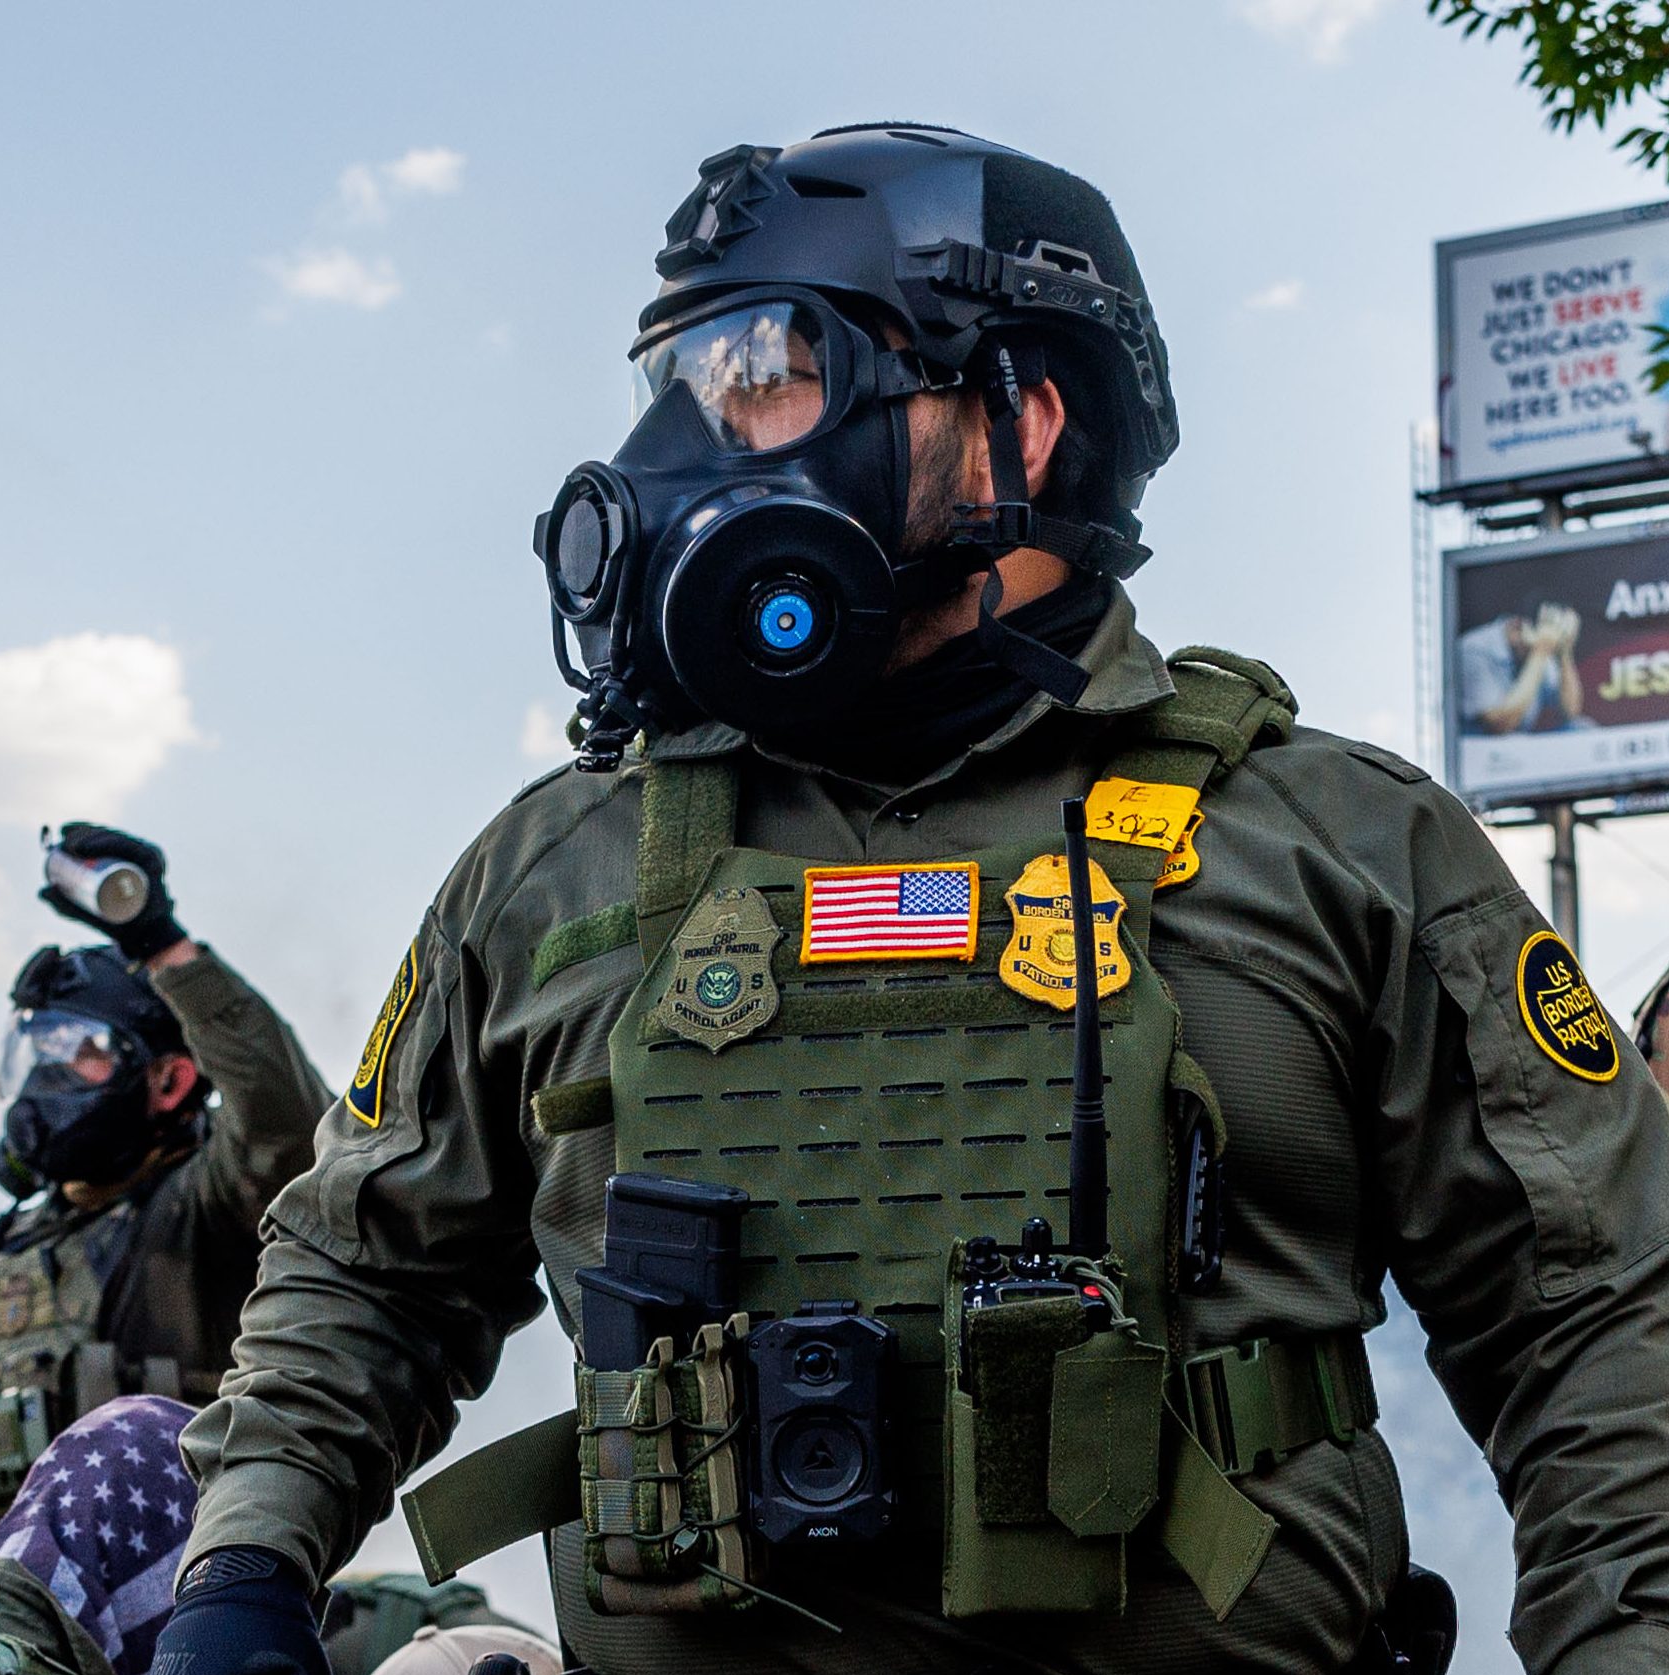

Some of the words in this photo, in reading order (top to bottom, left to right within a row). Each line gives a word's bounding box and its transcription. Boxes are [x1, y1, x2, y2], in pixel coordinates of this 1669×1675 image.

[1491, 273, 1535, 300] WE
[1543, 259, 1632, 296] DON'T
[1481, 305, 1546, 338] JUST
[1553, 287, 1644, 325] SERVE
[1490, 321, 1632, 365] CHICAGO.
[1506, 366, 1550, 390] WE
[1557, 353, 1618, 387] LIVE
[1484, 393, 1559, 425] HERE
[1569, 382, 1632, 410] TOO.
[1023, 905, 1065, 918] BORDER
[1052, 898, 1072, 909] CB
[683, 945, 722, 958] BORDER
[724, 943, 762, 953] PATROL
[712, 932, 737, 945] CBP
[1019, 935, 1031, 951] U
[1099, 942, 1112, 956] S
[675, 977, 687, 994] U
[751, 972, 764, 989] S
[1019, 961, 1067, 988] PATROL
[1544, 960, 1572, 987] U.S.
[674, 1001, 718, 1028] PATROL
[721, 999, 762, 1028] AGENT
[1544, 985, 1594, 1026] BORDER
[1558, 1010, 1606, 1050] PATROL
[808, 1526, 838, 1537] AXON
